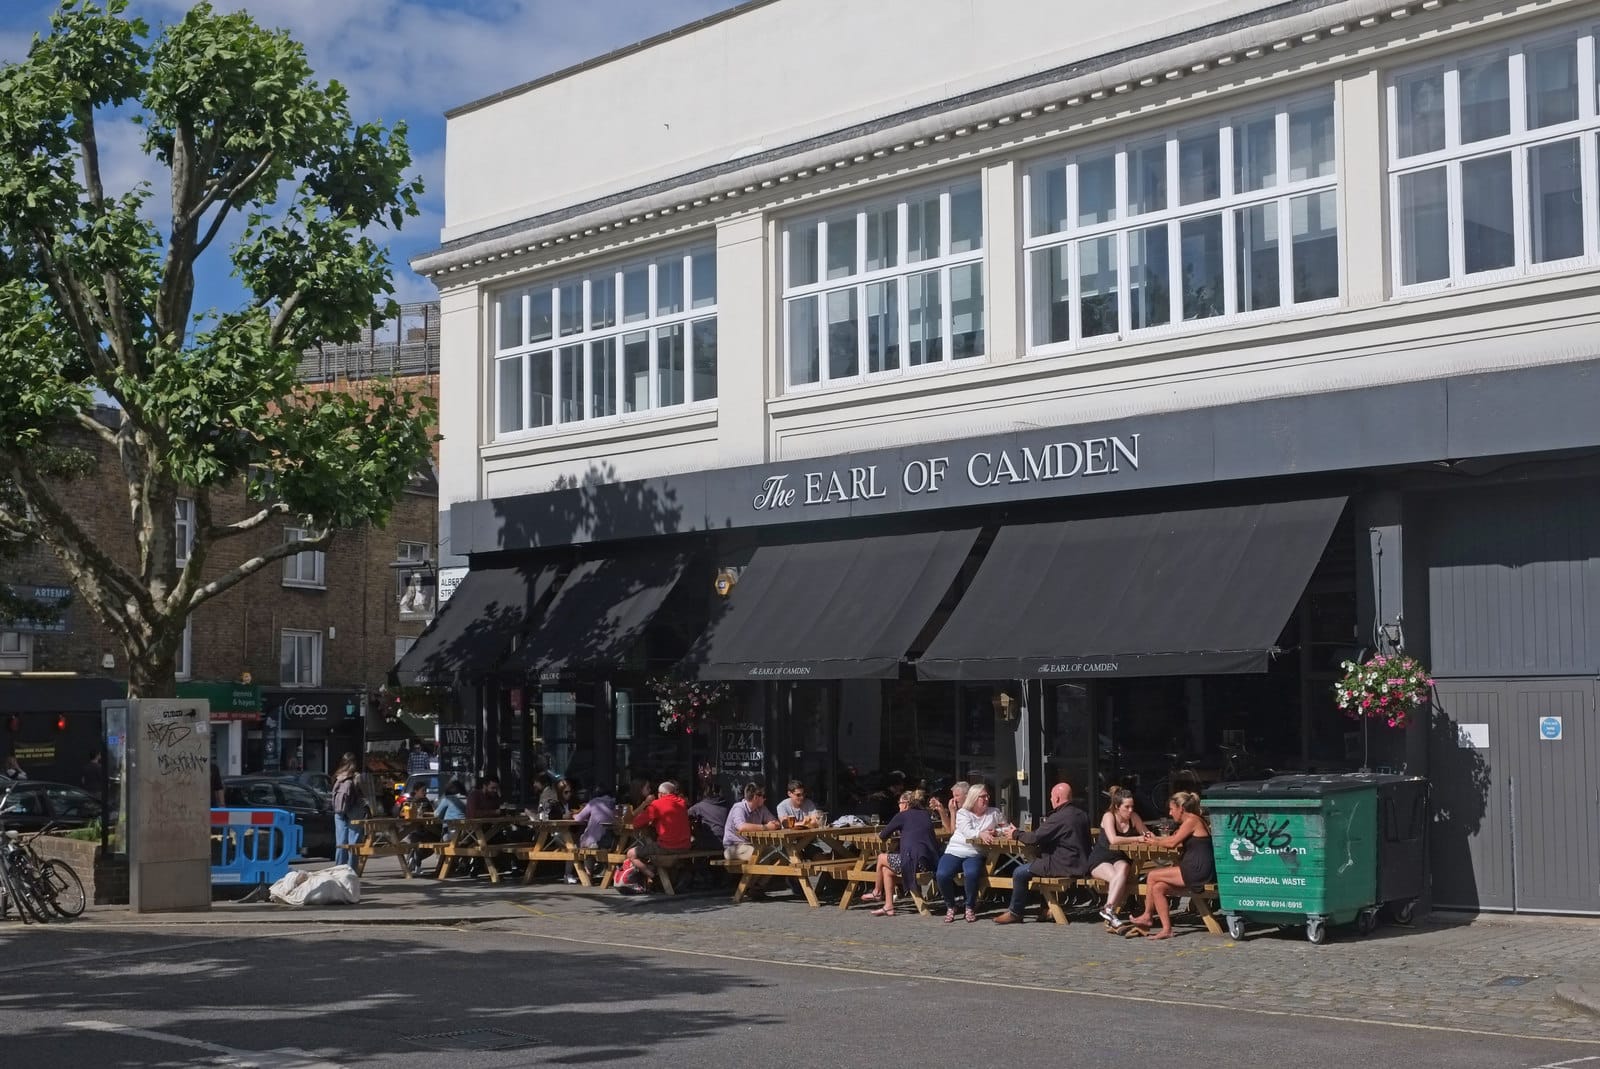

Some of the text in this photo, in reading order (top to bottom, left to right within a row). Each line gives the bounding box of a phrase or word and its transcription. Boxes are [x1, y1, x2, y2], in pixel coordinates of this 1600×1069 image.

[752, 433, 1141, 510] The EARL OF CAMDEN
[758, 666, 774, 675] EARL
[774, 666, 783, 675] OF
[783, 666, 811, 675] CAMDEN
[1050, 663, 1071, 673] EARL
[1071, 663, 1082, 672] OF
[1083, 662, 1119, 672] CAMDEN
[446, 729, 470, 744] WINE
[1233, 875, 1306, 886] COMMERCIAL WASTE
